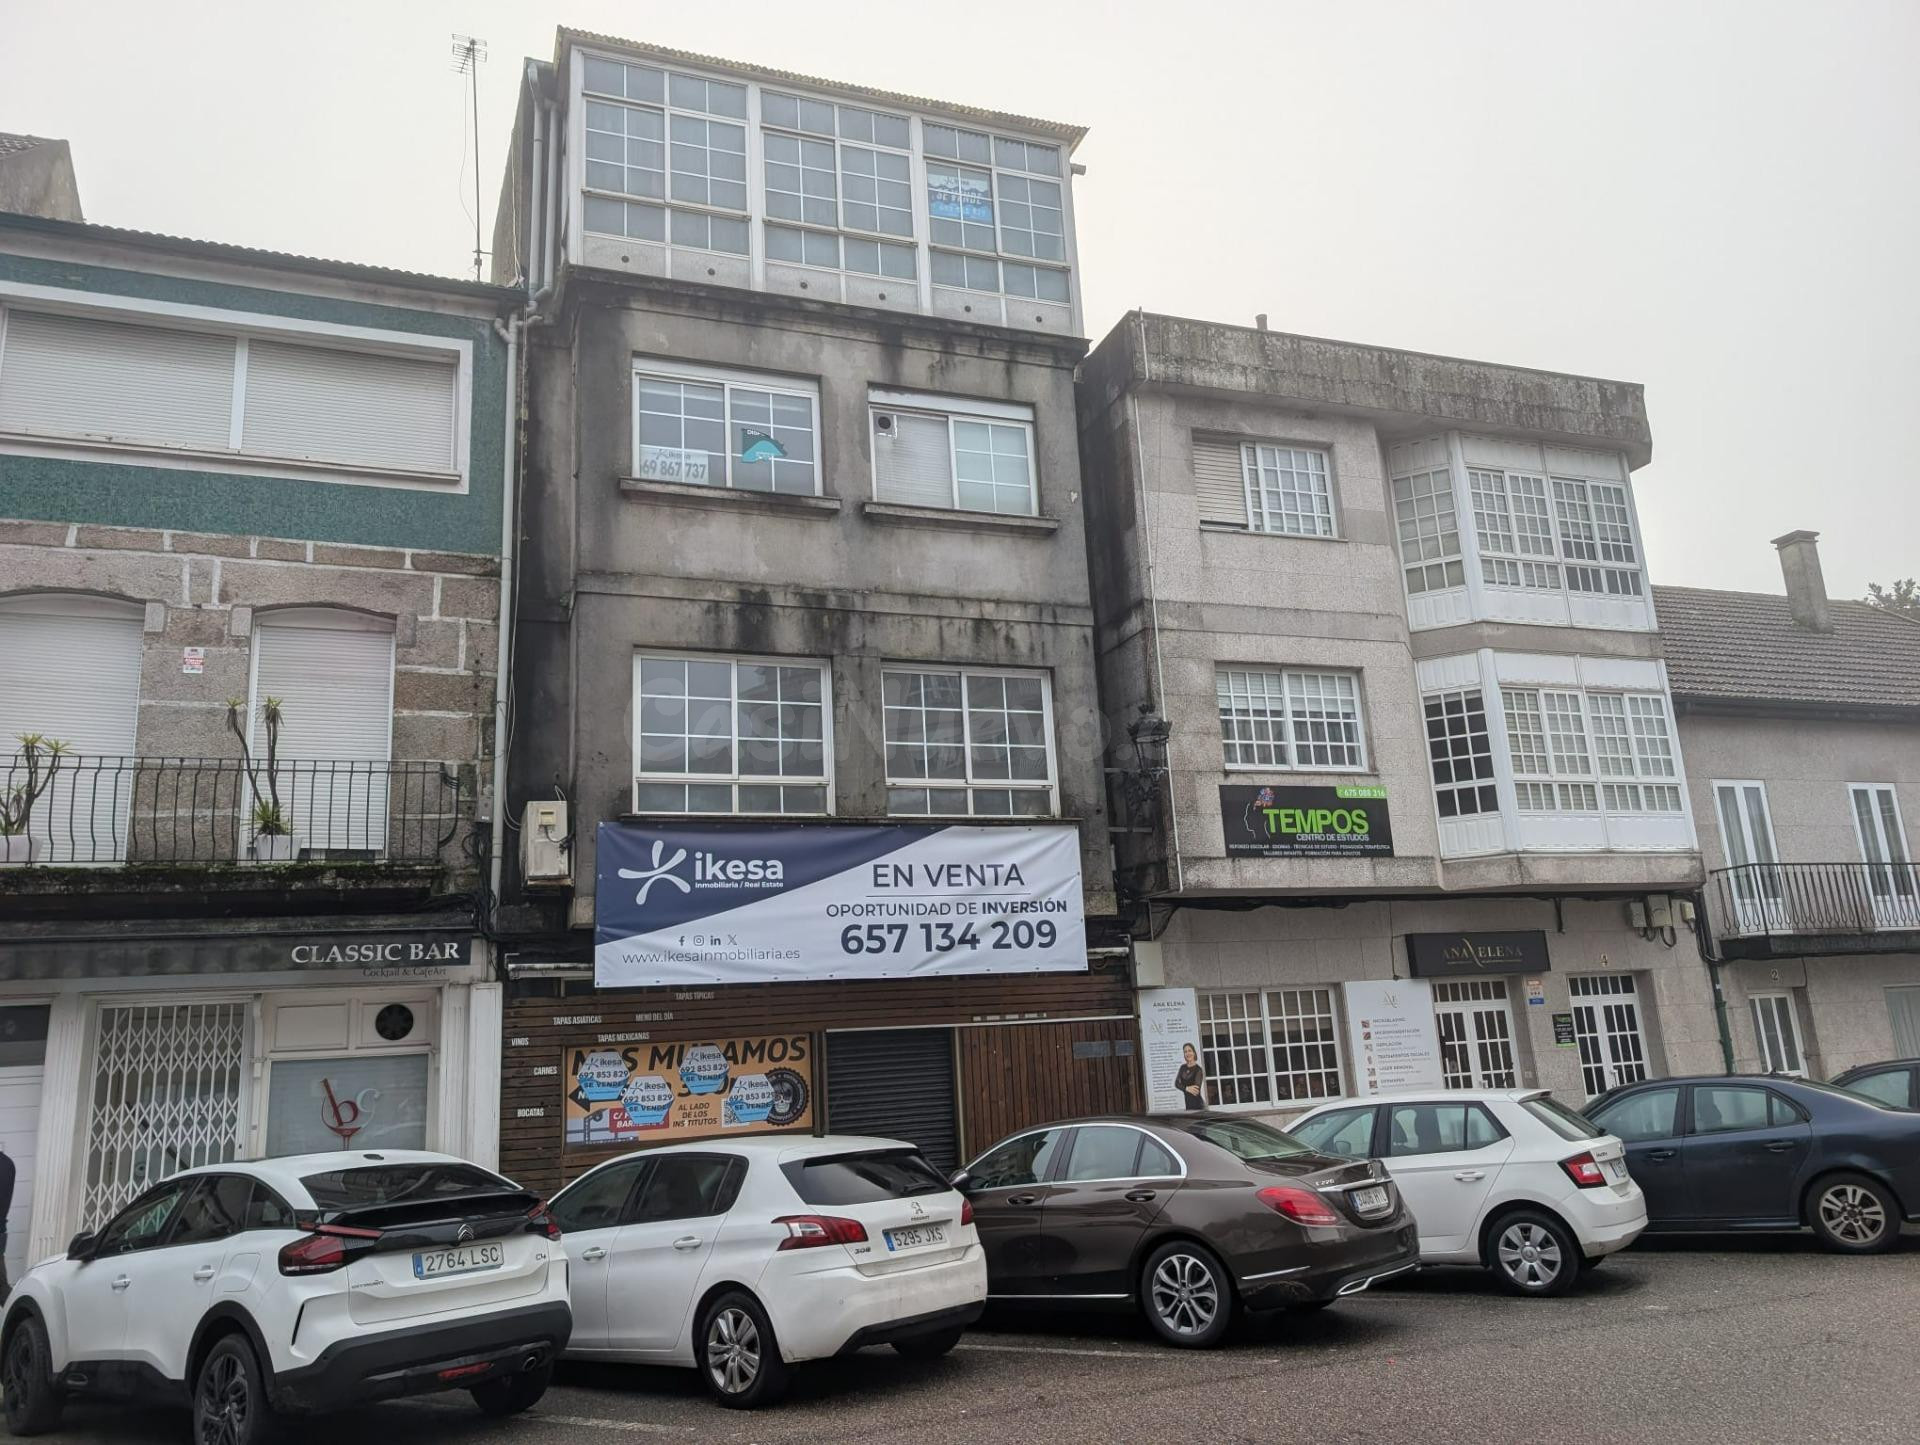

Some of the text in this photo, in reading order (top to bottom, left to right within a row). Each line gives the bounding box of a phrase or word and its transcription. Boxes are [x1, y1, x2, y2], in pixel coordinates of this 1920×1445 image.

[660, 462, 682, 477] 867
[685, 464, 706, 479] 737
[1263, 808, 1369, 834] TEMPOS
[1296, 833, 1370, 842] CENTRO DE ESTUDOS
[695, 852, 784, 880] ikesa
[873, 863, 1025, 887] EN VENTA
[826, 897, 1067, 917] OPORTUNIDAD DE INVERSIÓN
[841, 919, 1057, 954] 657 134 209
[291, 942, 460, 963] CLASSIC BAR
[622, 948, 800, 964] www.ikesainmobiliaria.es
[362, 967, 400, 978] Cocktail
[402, 968, 411, 976] &
[1771, 968, 1780, 982] 2
[675, 992, 693, 1001] TAPAS
[553, 1016, 572, 1025] TAPAS
[653, 1012, 663, 1021] DEL
[511, 1037, 529, 1047] VINOS
[597, 1032, 650, 1043] TAPAS MEXICANAS
[571, 1036, 807, 1077] NS MUAMOS
[700, 1051, 721, 1060] ikesa
[600, 1058, 622, 1066] ikesa
[533, 1066, 557, 1076] CARNES
[680, 1063, 728, 1073] 692 853 829
[579, 1071, 594, 1079] 692
[613, 1070, 628, 1078] 829
[644, 1081, 666, 1090] ikesa
[748, 1080, 769, 1088] ikesa
[624, 1095, 639, 1103] 692
[729, 1094, 743, 1102] 692
[745, 1092, 760, 1100] 853
[690, 1102, 710, 1110] LADO
[517, 1108, 544, 1117] BOCATAS
[893, 1227, 943, 1246] 5295 JXS
[855, 1246, 871, 1255] 308
[425, 1246, 499, 1272] 2764 LSC
[535, 1253, 547, 1261] C4
